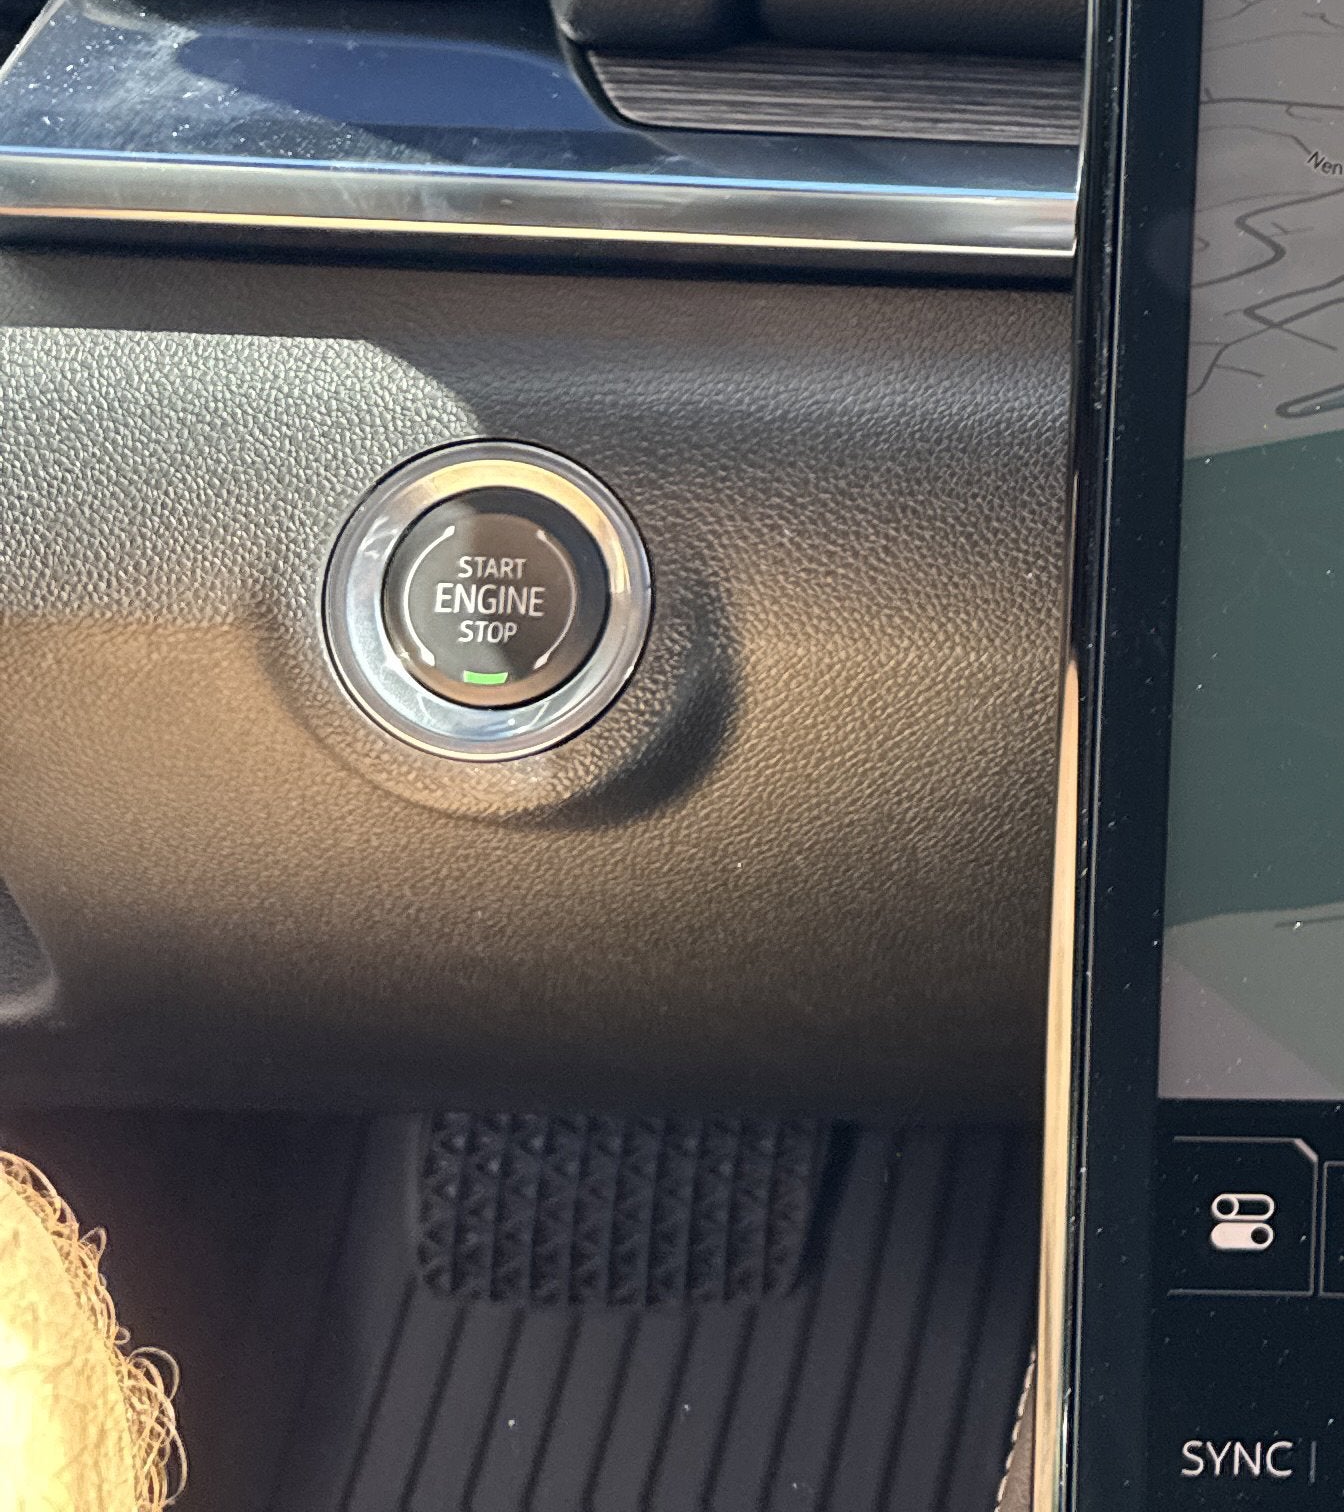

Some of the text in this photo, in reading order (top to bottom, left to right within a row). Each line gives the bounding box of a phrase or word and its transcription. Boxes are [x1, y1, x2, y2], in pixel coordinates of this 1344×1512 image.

[458, 556, 526, 579] START
[434, 583, 546, 616] ENGINE
[458, 620, 518, 643] STOP
[1181, 1441, 1293, 1478] SYNC
